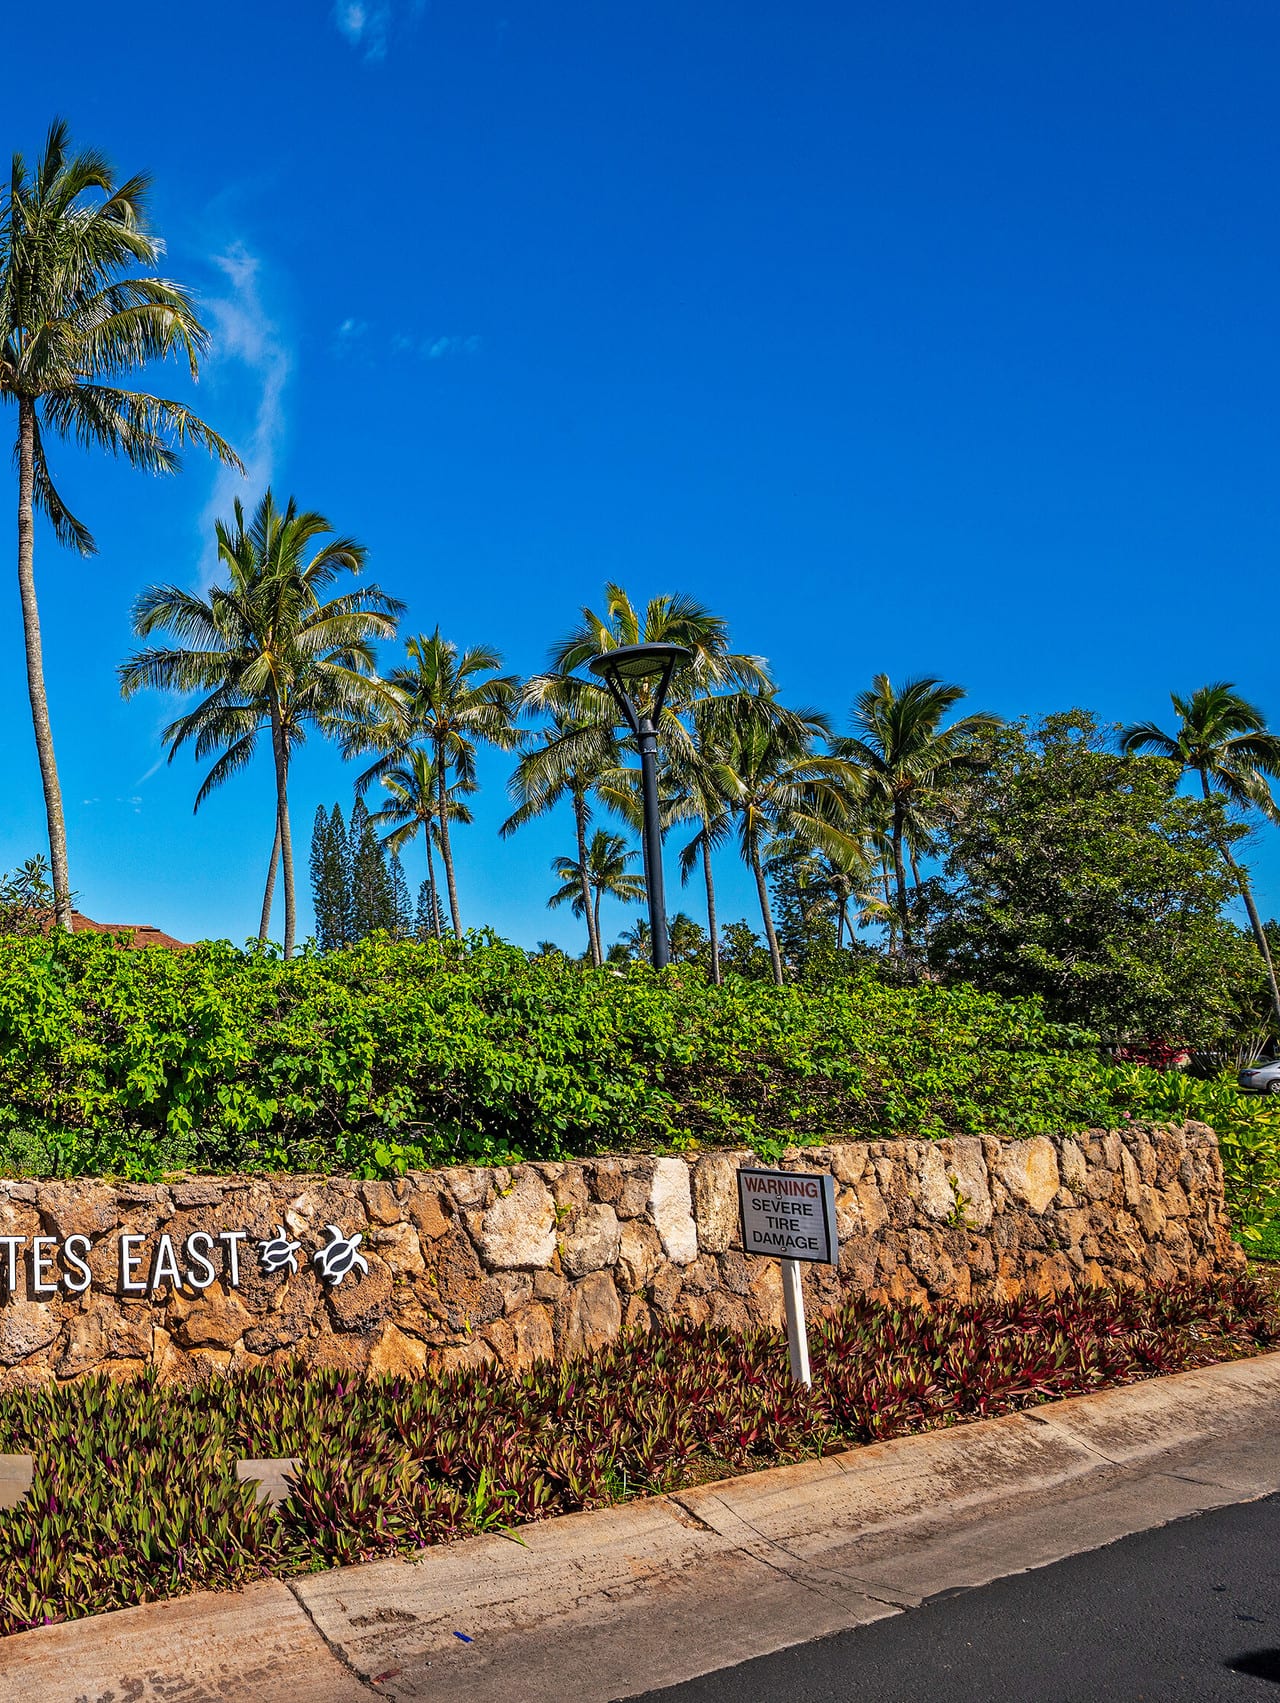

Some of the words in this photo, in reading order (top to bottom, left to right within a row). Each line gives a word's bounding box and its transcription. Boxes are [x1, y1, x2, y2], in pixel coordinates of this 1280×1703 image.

[744, 1177, 818, 1198] WARNING
[752, 1199, 814, 1216] SEVERE
[765, 1216, 801, 1231] TIRE
[752, 1230, 819, 1250] DAMAGE
[122, 1231, 248, 1290] EAST
